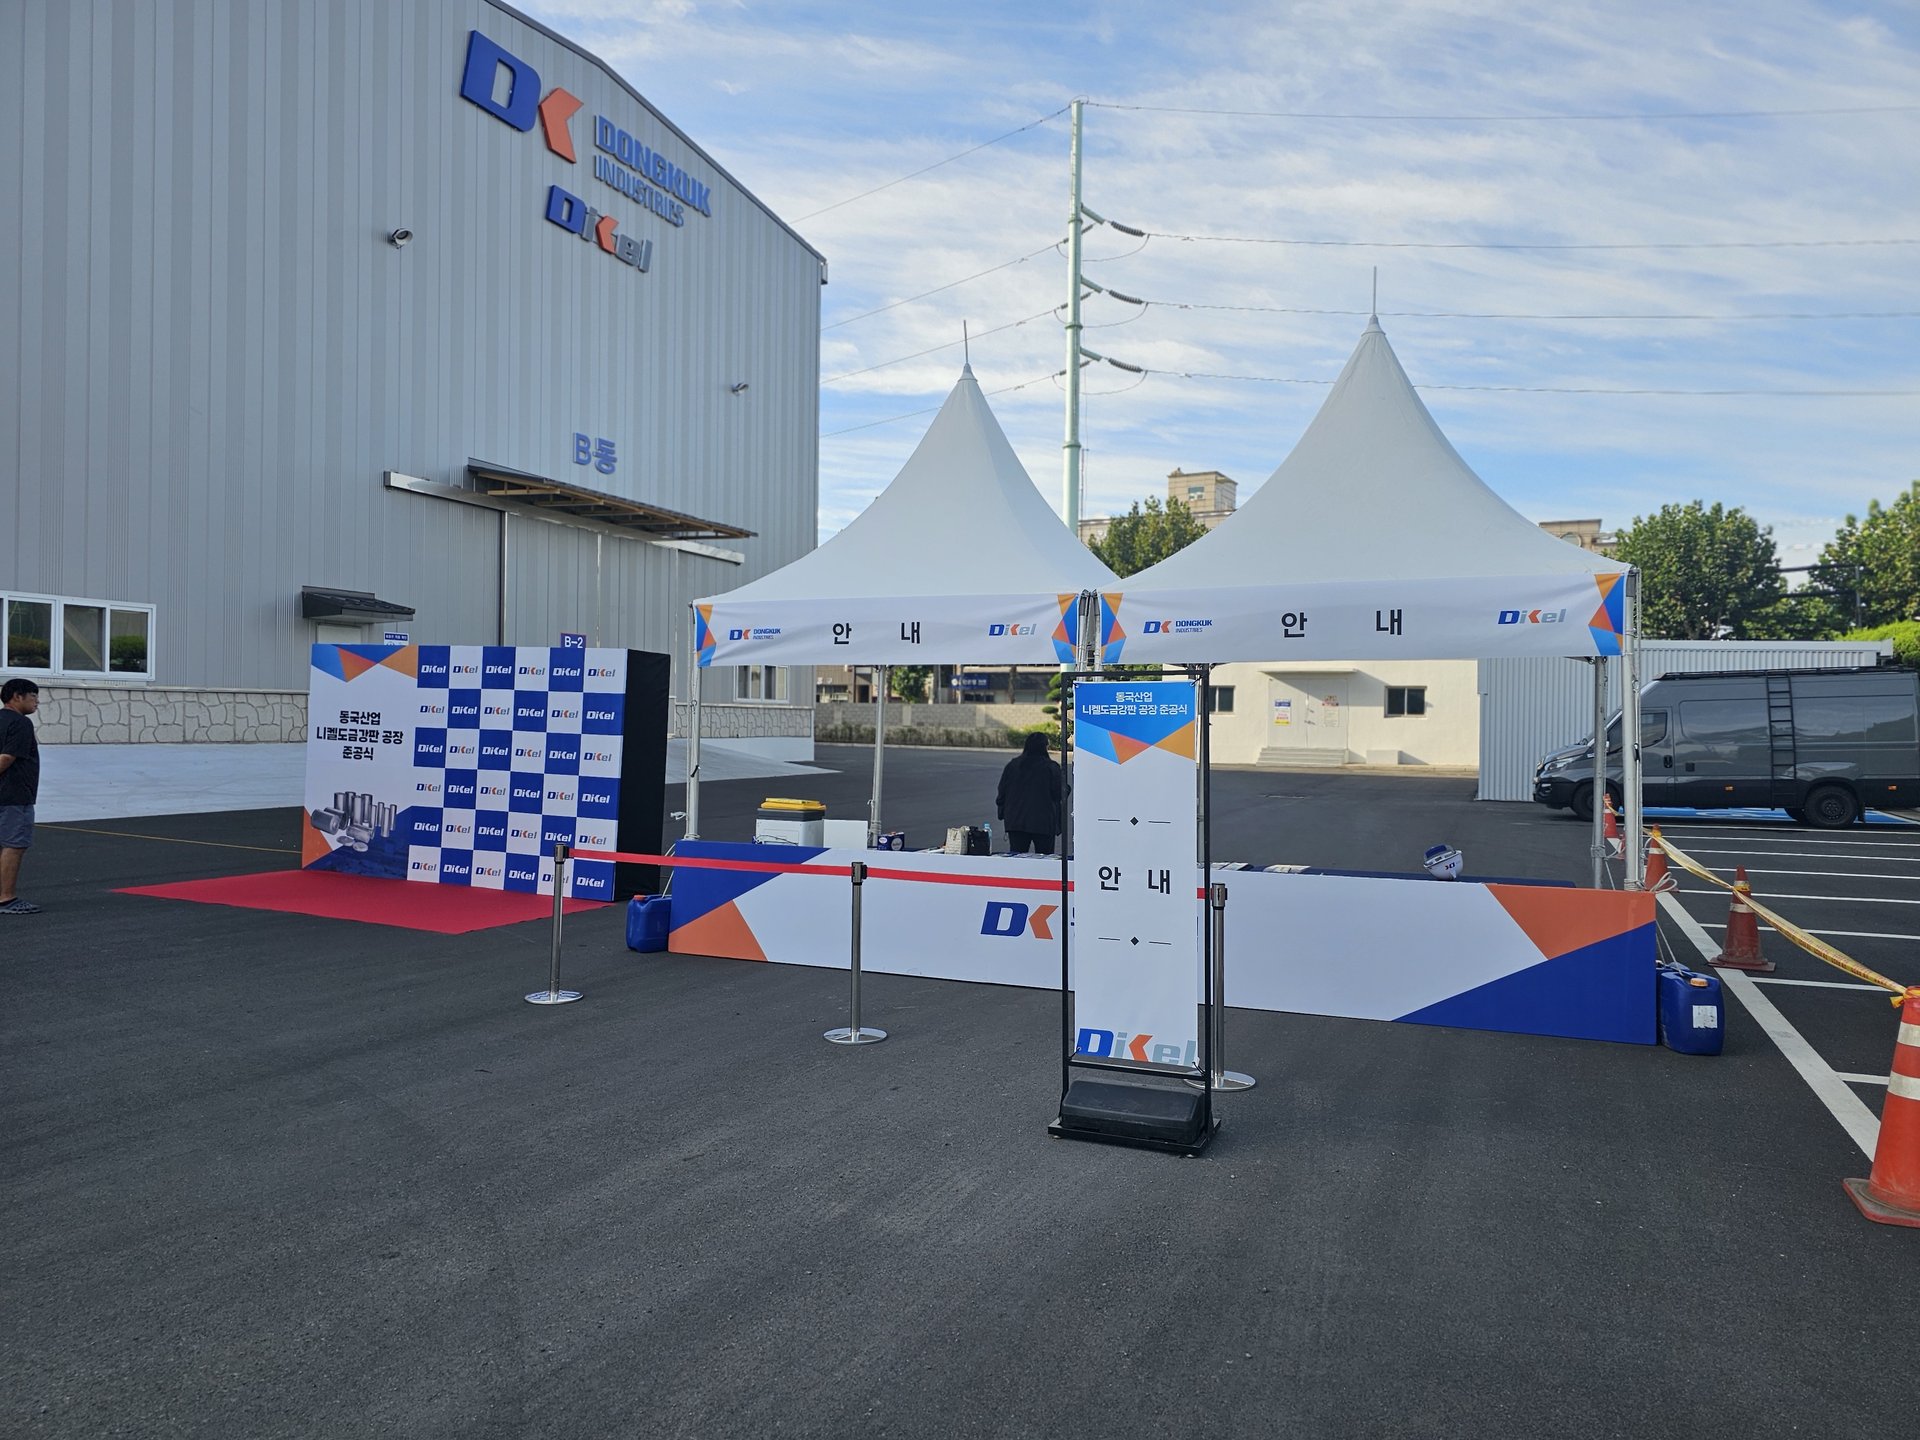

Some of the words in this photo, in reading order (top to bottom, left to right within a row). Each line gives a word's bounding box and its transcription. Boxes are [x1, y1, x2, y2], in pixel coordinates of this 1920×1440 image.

[594, 114, 711, 217] DONGKUK
[594, 154, 684, 228] INDUSTRIES
[573, 432, 618, 475] B동
[564, 635, 584, 649] B-2
[1115, 691, 1153, 703] 동국산업
[1082, 704, 1137, 715] 니켈도금강판
[1138, 705, 1158, 715] 공장
[1159, 704, 1188, 715] 준공식
[340, 710, 381, 726] 동국산업
[316, 726, 379, 743] 니켈도금강판
[382, 730, 404, 745] 공장
[343, 746, 374, 761] 준공식
